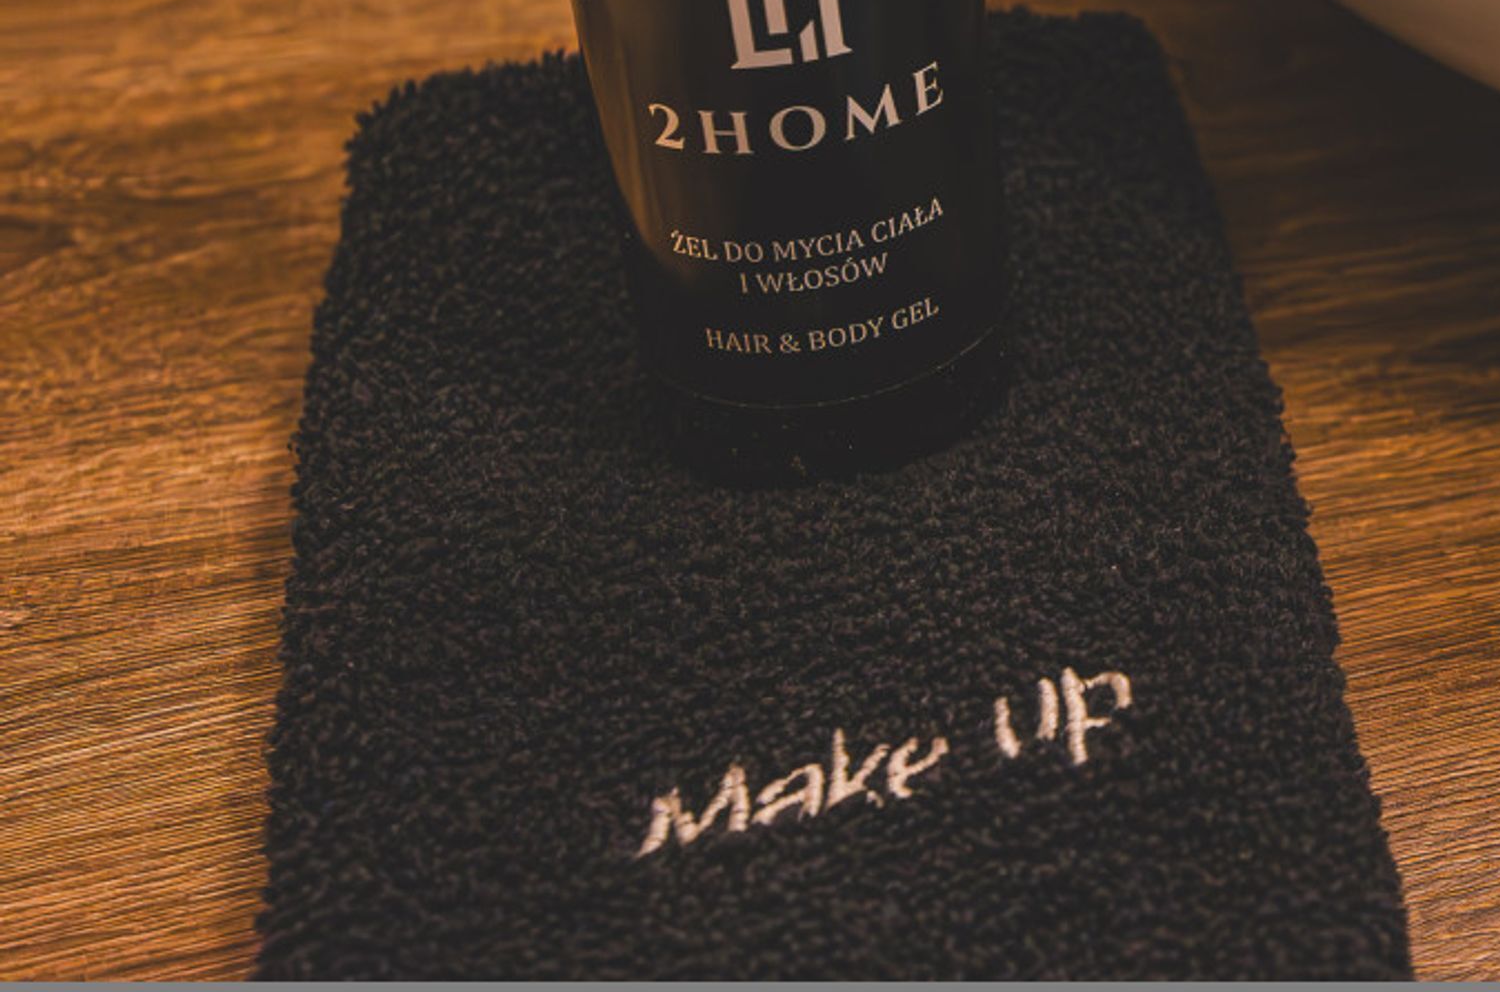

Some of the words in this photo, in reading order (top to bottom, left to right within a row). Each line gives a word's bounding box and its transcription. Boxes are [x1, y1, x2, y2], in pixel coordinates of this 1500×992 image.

[648, 61, 944, 154] 2HOME
[669, 229, 718, 261] ŻEL
[724, 239, 764, 263] DO
[772, 229, 864, 263] MYCIA
[871, 197, 944, 244] CIAŁA
[740, 273, 748, 294] I
[756, 253, 888, 295] WŁOSÓW
[705, 327, 772, 355] HAIR
[779, 333, 801, 354] &
[808, 317, 884, 351] BODY
[891, 297, 939, 330] GEL
[635, 727, 949, 859] Make
